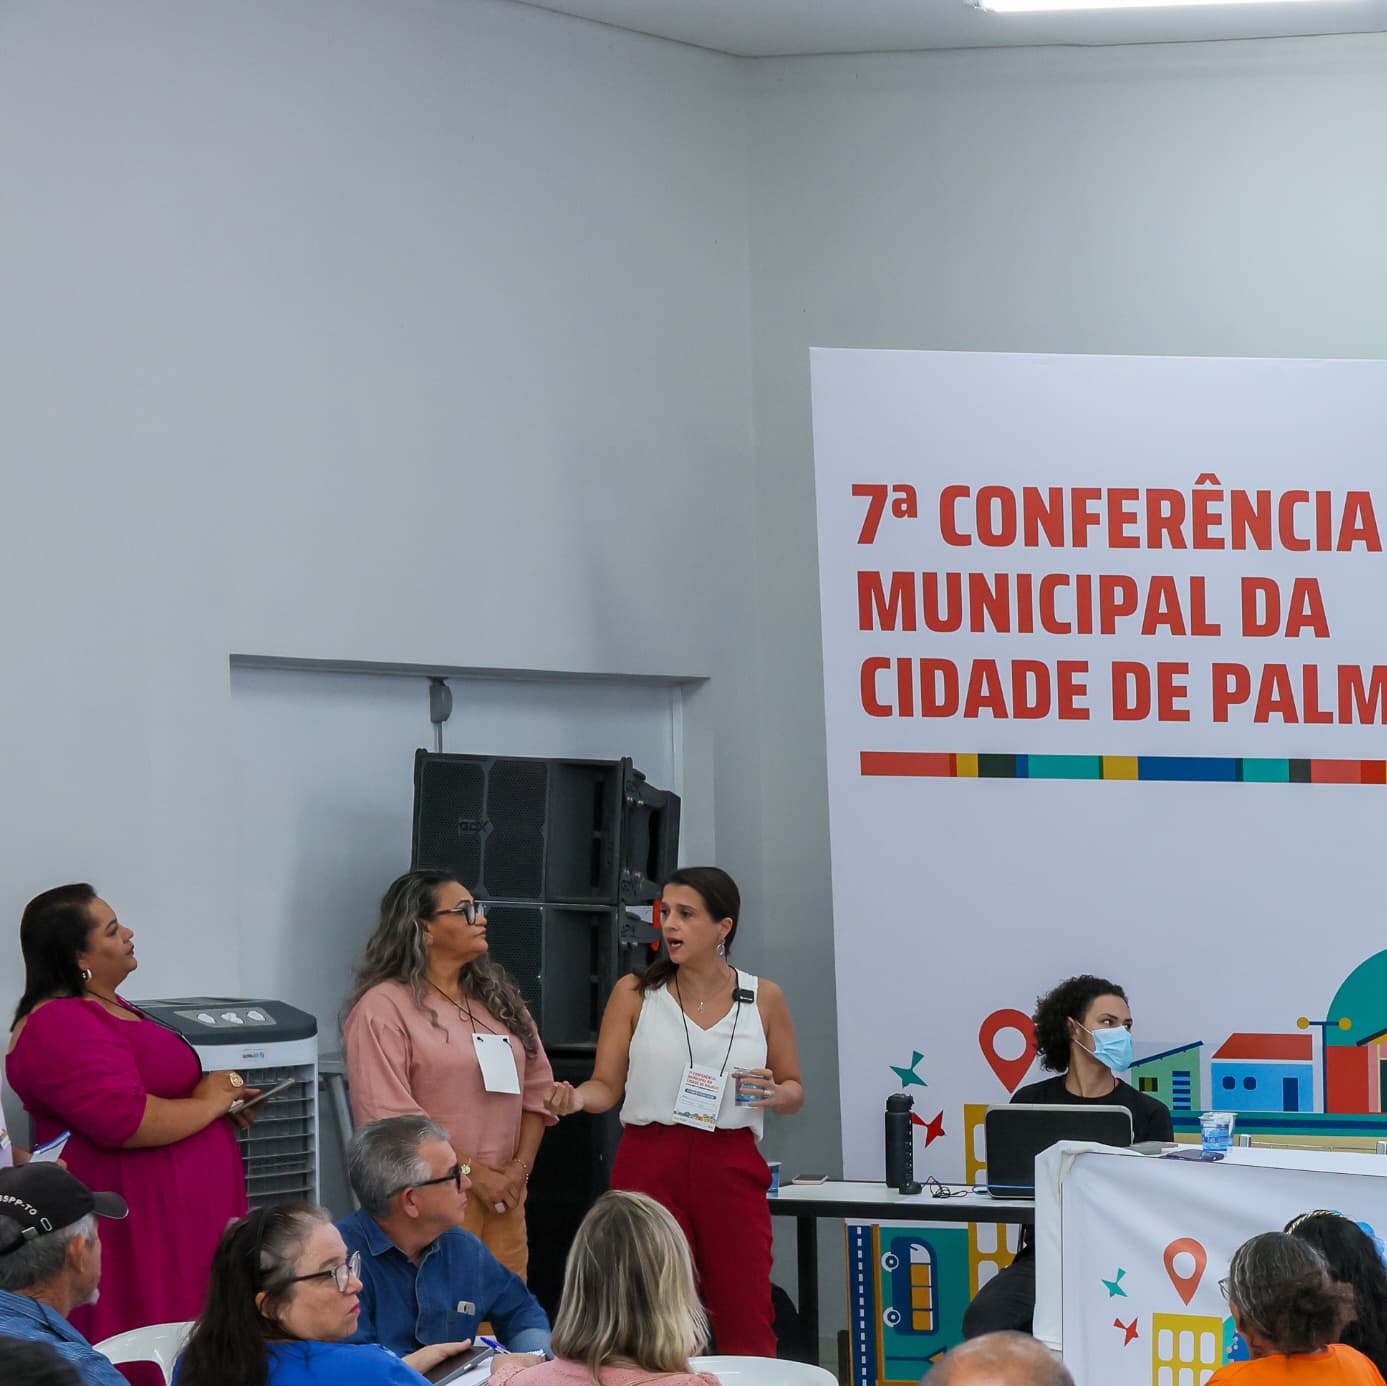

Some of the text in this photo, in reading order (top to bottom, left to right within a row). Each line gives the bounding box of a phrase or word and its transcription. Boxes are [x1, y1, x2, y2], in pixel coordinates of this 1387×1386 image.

[852, 473, 1383, 552] 7ª CONFERÊNCIA
[857, 571, 1330, 638] MUNICIPAL DA
[860, 657, 1090, 720] CIDADE
[1112, 661, 1191, 722] DE
